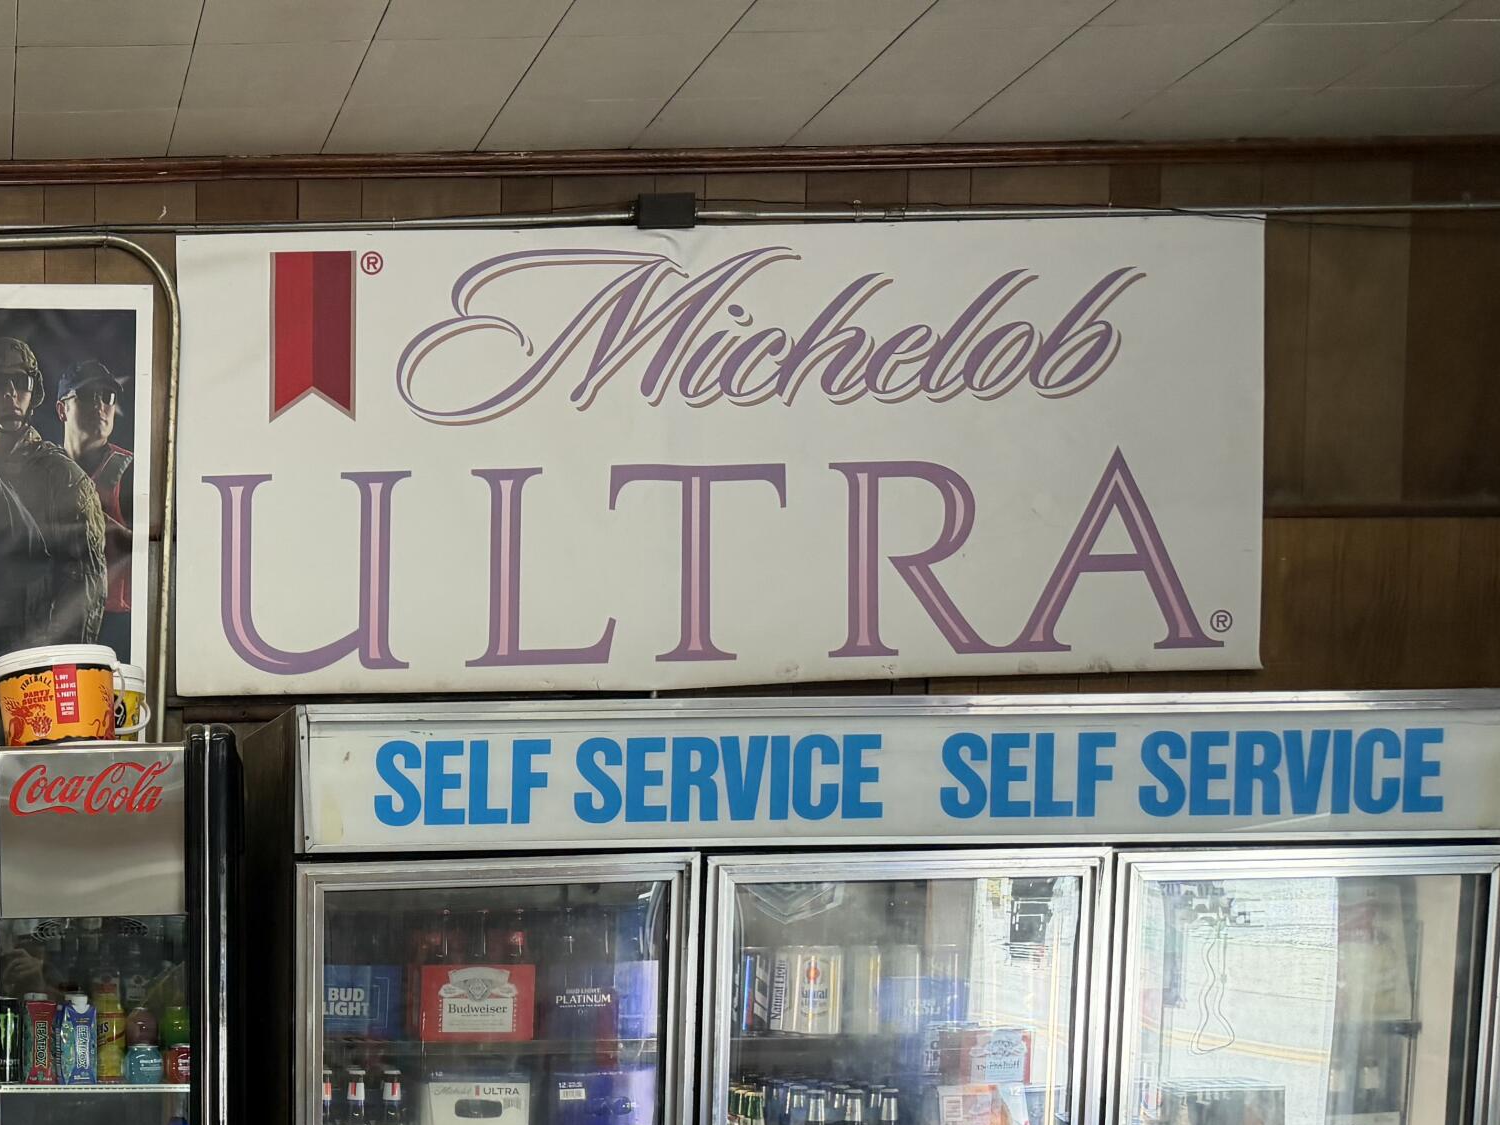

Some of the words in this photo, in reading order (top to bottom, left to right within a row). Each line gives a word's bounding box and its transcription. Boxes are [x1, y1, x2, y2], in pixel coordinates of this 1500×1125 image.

[395, 245, 1147, 427] Michelob
[202, 446, 1225, 676] ULTRA
[373, 739, 549, 827] SELF
[574, 734, 883, 824] SERVICE
[939, 732, 1115, 819] SELF
[1138, 728, 1443, 818] SERVICE
[9, 757, 174, 816] Coca-Cola
[328, 988, 365, 1001] BUD
[555, 994, 611, 1005] PLATINUM
[323, 1001, 370, 1016] LIGHT
[448, 1003, 508, 1014] Budweiser
[483, 1087, 520, 1096] ULTRA
